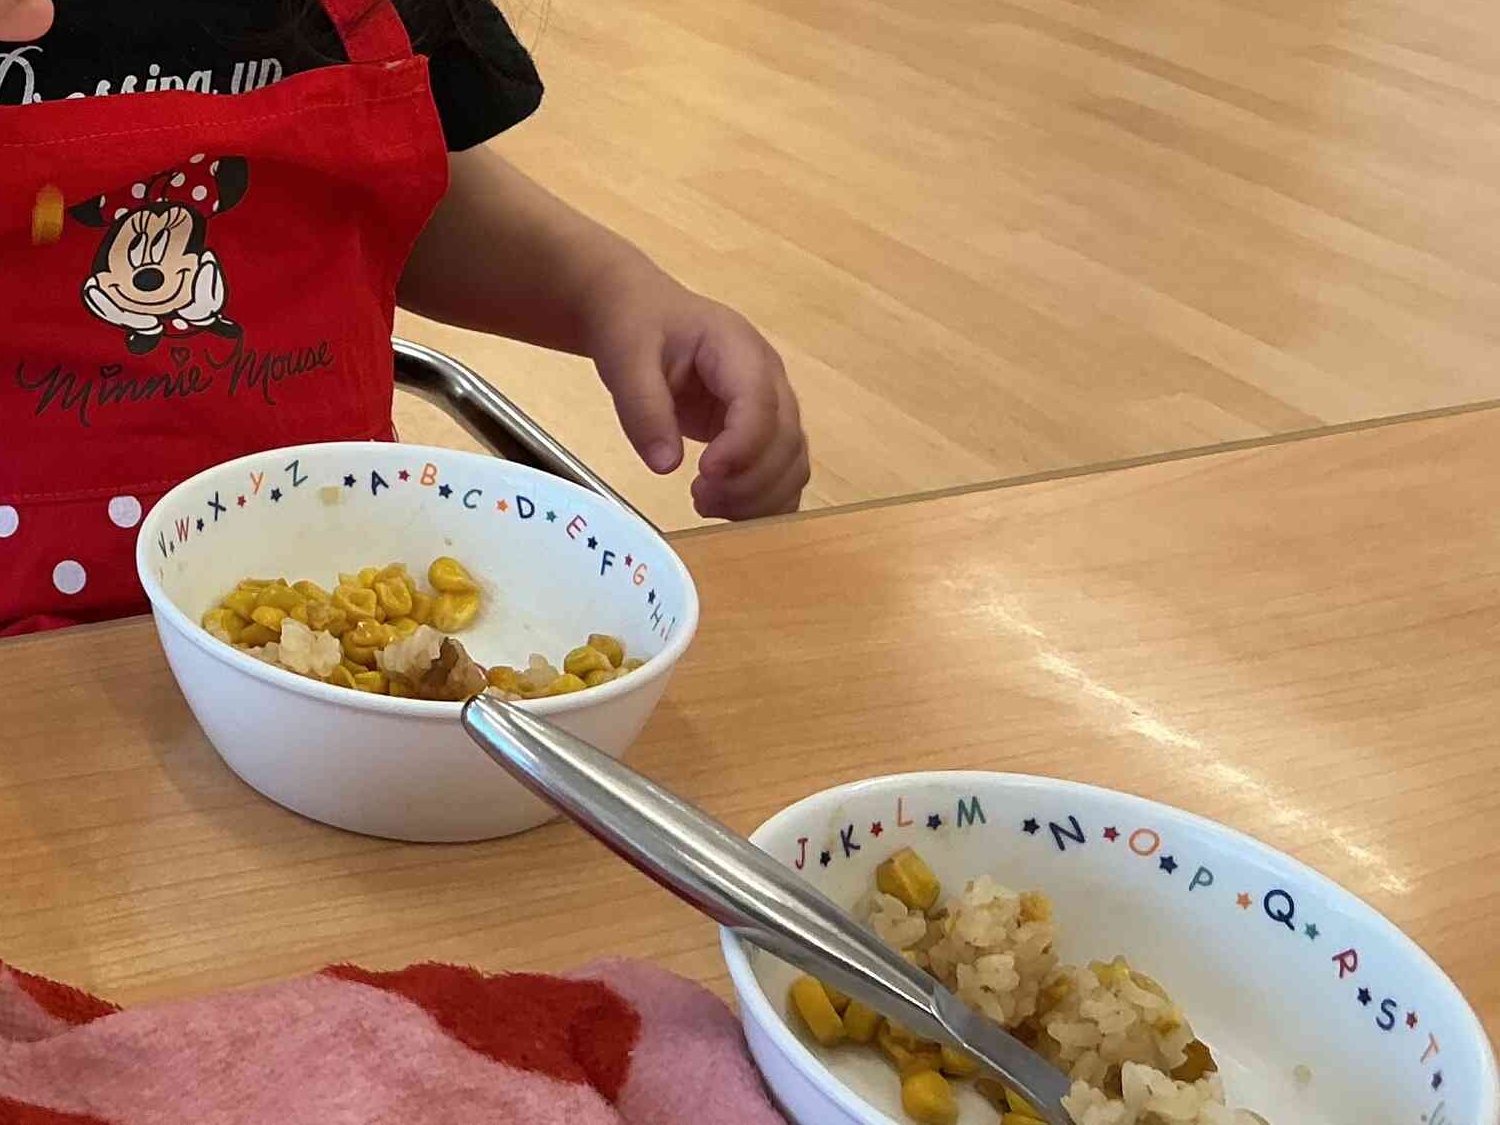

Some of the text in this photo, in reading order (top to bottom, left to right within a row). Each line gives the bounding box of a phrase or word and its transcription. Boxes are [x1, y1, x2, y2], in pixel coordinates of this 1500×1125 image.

[15, 340, 334, 427] Minnie Mouse
[175, 516, 190, 543] W
[207, 491, 227, 521] X
[250, 472, 264, 496] Y
[284, 459, 308, 487] Z
[371, 470, 389, 496] A
[420, 463, 438, 486] B
[463, 489, 483, 509] C
[516, 495, 536, 519] D
[566, 514, 588, 539] E
[600, 550, 616, 576] F
[796, 837, 808, 870] J
[840, 824, 861, 858] K
[897, 797, 914, 827] L
[957, 796, 986, 828] M
[1049, 815, 1086, 851] N
[1128, 828, 1160, 856] O
[1188, 866, 1213, 891] P
[1263, 889, 1295, 931] Q
[1332, 948, 1358, 979] R
[1375, 998, 1397, 1031] S
